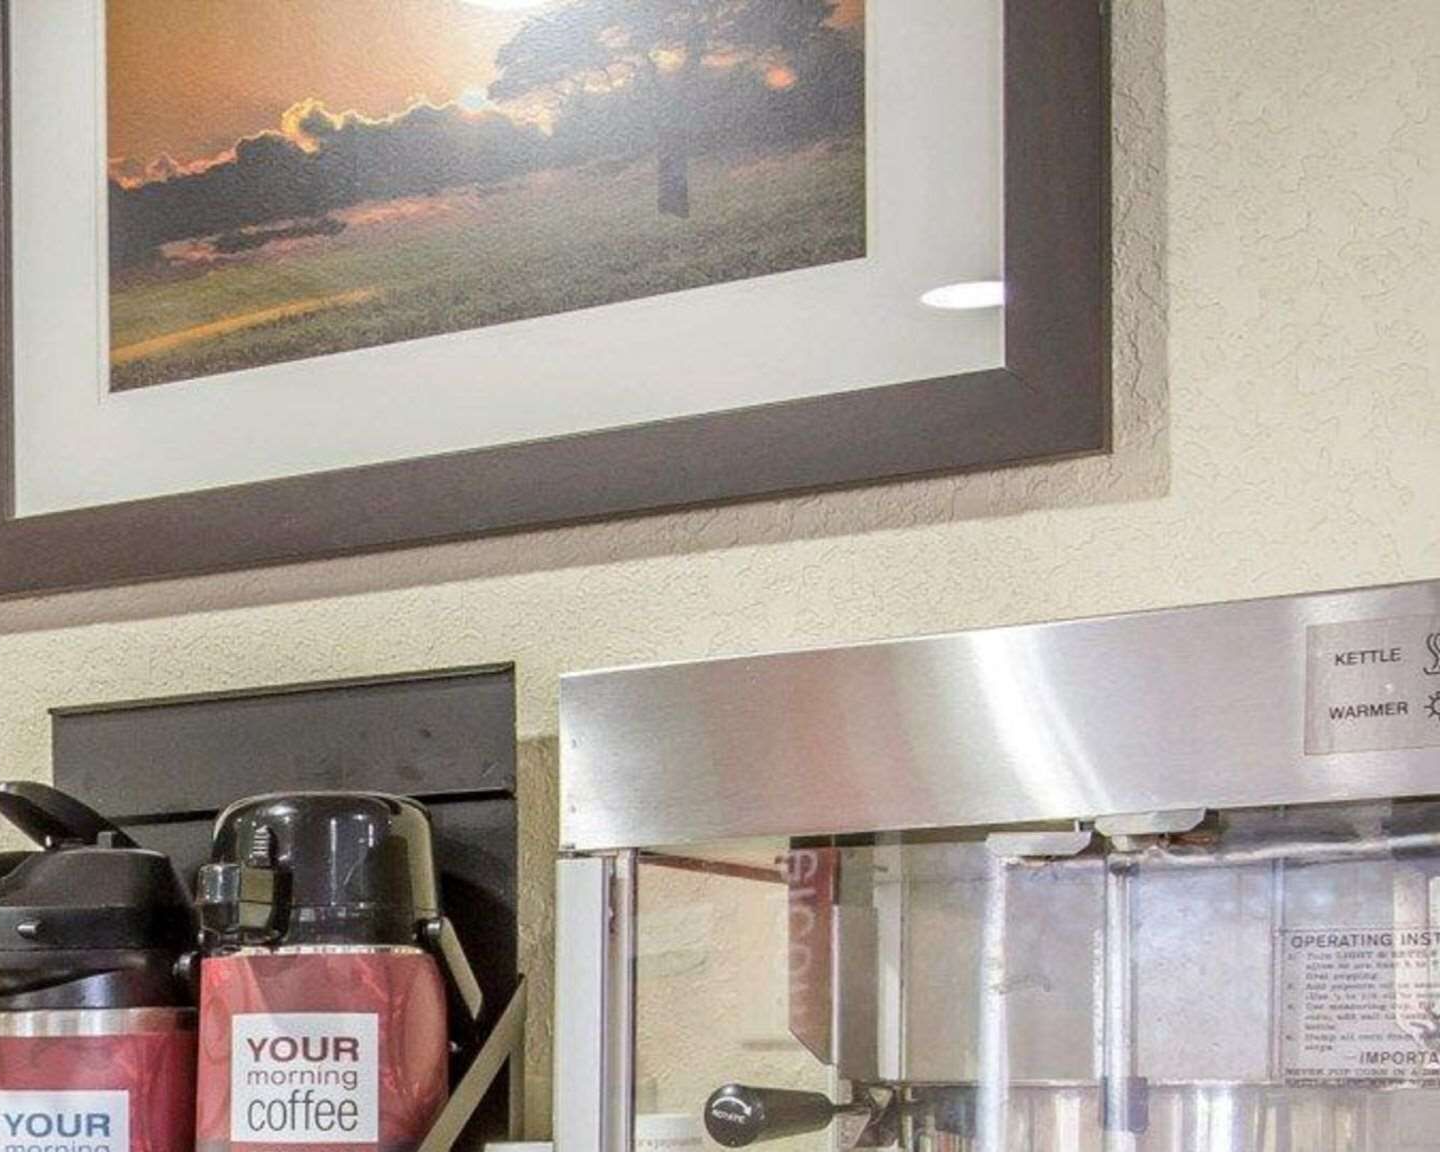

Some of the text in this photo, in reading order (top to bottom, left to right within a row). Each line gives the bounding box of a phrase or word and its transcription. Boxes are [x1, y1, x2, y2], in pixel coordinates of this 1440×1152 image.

[1334, 648, 1401, 666] KETTLE
[1329, 701, 1408, 720] WARMER
[1291, 933, 1392, 948] OPERATING
[247, 1036, 359, 1062] YOUR
[247, 1067, 358, 1091] morning
[247, 1090, 358, 1132] coffee
[3, 1113, 111, 1138] YOUR
